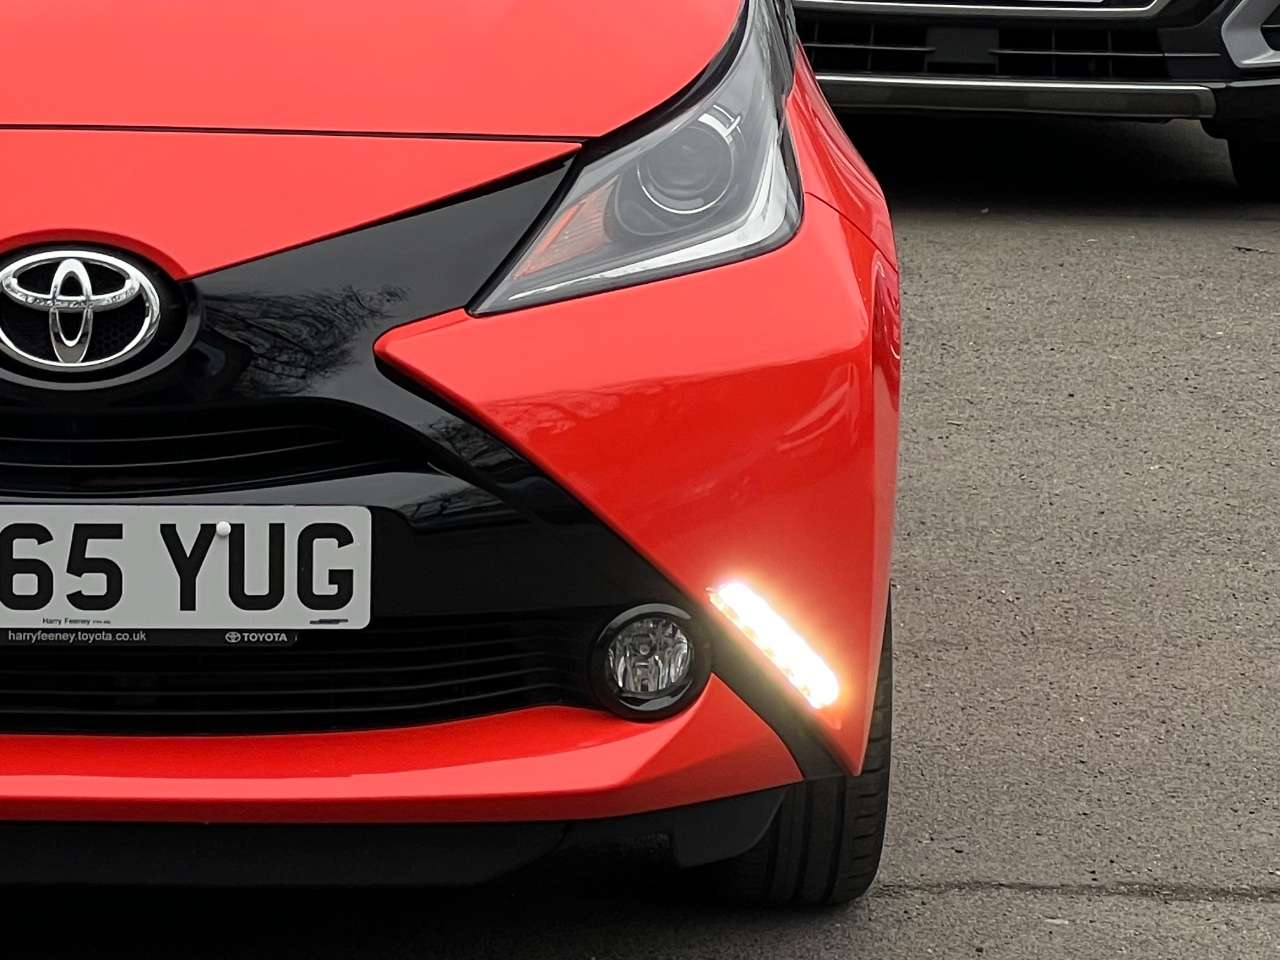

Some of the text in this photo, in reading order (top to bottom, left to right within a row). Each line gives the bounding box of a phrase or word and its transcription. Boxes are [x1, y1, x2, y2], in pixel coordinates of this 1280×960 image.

[160, 522, 355, 612] YUG
[42, 617, 61, 626] Harry
[8, 629, 147, 644] harryfeeney.toyota.co.uk
[242, 632, 288, 642] TOYOTA
